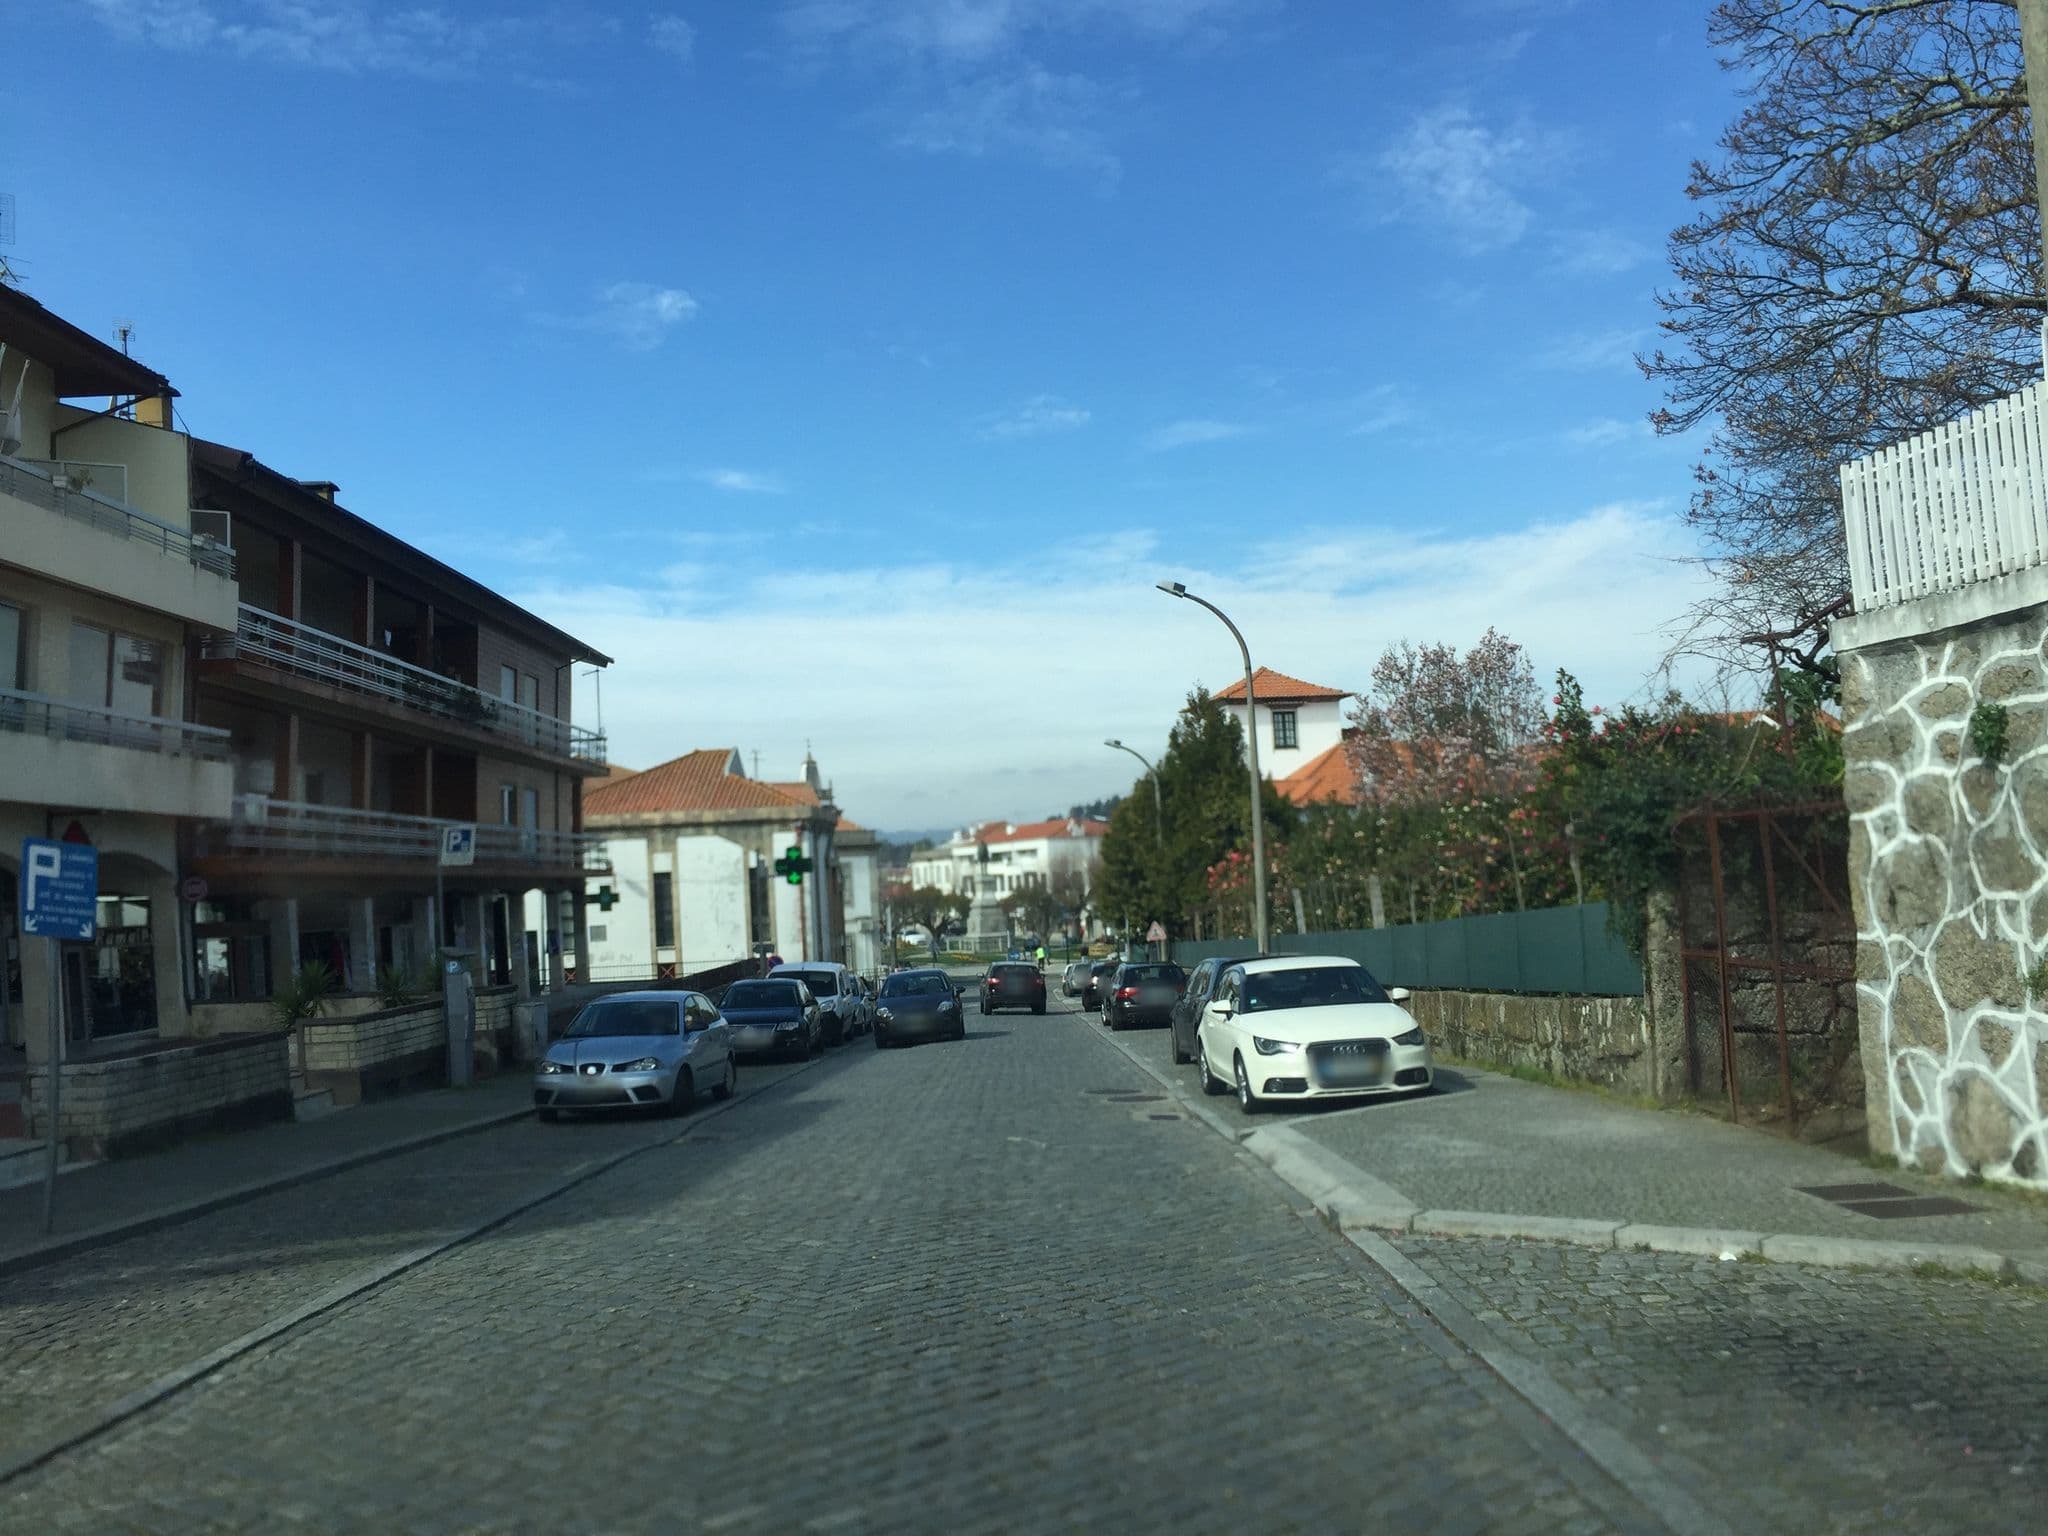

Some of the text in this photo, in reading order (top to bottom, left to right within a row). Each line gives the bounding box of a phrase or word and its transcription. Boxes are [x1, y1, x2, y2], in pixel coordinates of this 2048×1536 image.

[449, 832, 462, 850] P
[27, 845, 61, 911] P
[449, 961, 458, 973] P
